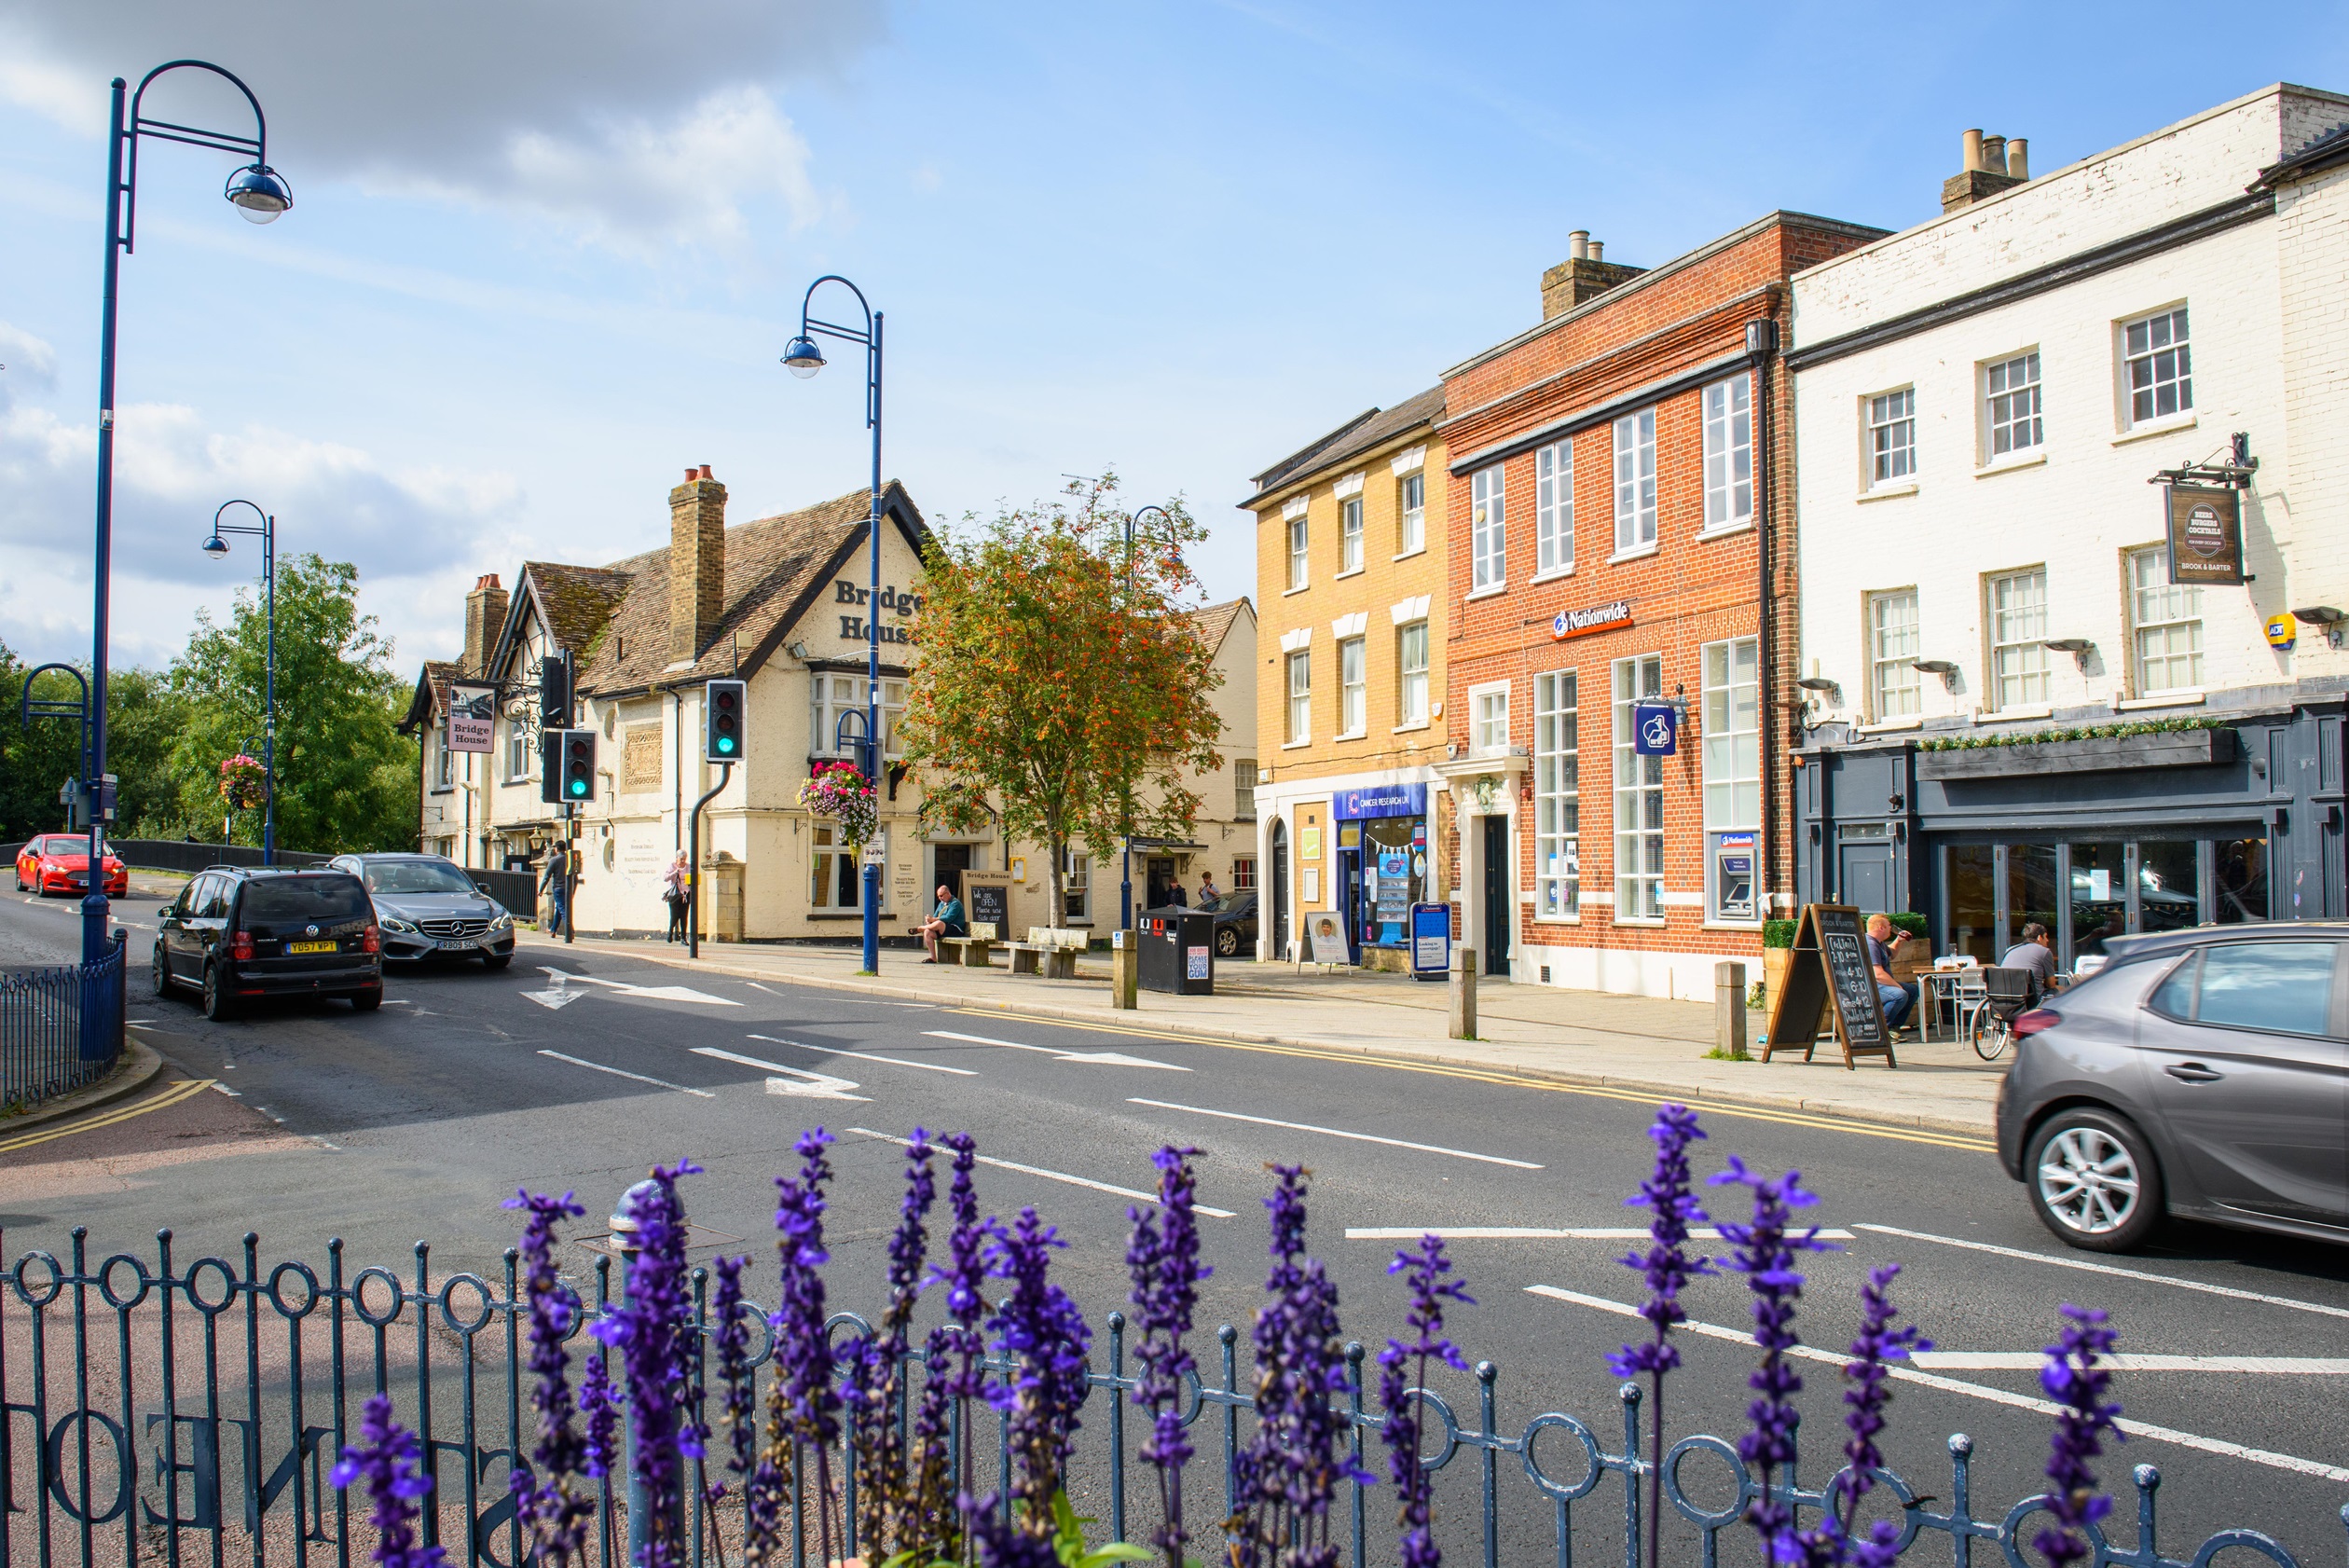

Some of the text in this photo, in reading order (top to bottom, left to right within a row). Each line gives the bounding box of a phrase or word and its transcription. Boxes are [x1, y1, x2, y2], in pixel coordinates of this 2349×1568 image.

[835, 580, 926, 616] Brdge
[1569, 602, 1628, 629] Nationwide
[2270, 625, 2284, 634] ADT
[454, 723, 489, 736] Bridge
[455, 735, 488, 745] House
[1360, 799, 1378, 807] CANCER
[1379, 796, 1401, 806] RESEARCH
[1401, 796, 1408, 805] UK
[973, 889, 982, 899] We
[981, 898, 997, 906] OPEN
[291, 942, 315, 952] YD57
[1188, 970, 1207, 978] GUM
